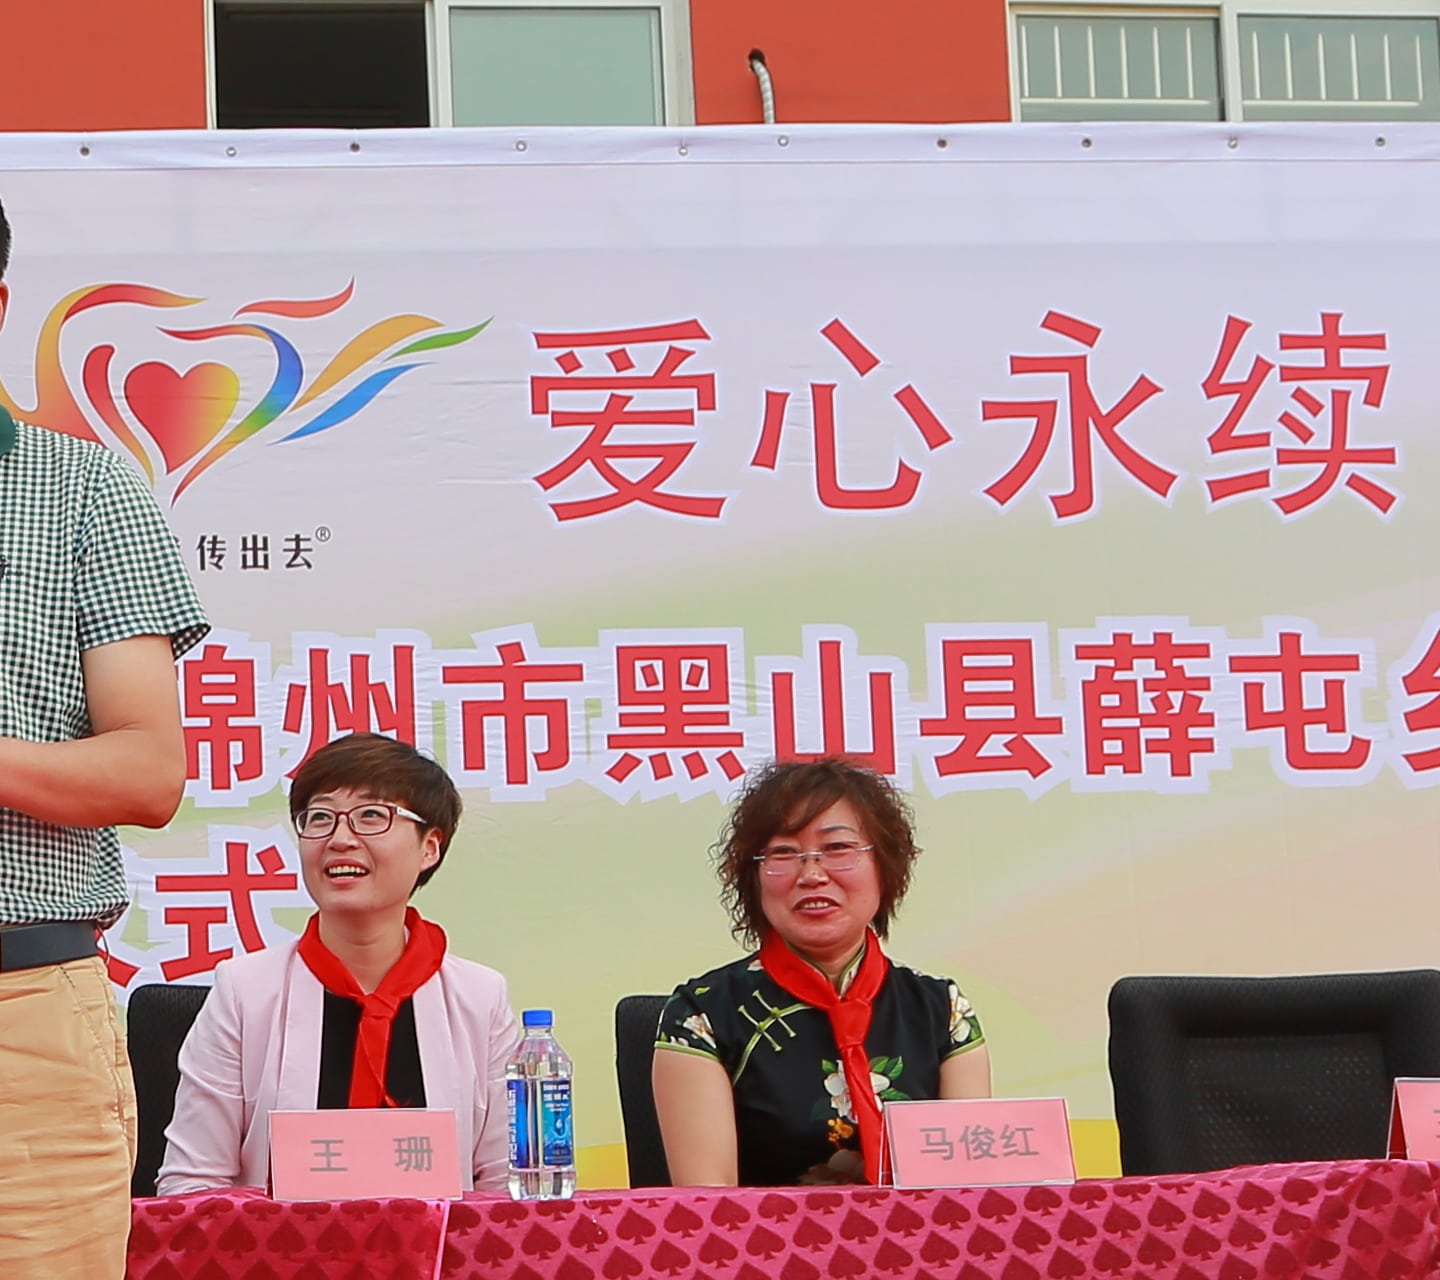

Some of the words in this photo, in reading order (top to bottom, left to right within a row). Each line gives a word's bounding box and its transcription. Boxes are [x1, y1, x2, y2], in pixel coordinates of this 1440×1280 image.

[530, 311, 1399, 522] 爱心永续
[919, 1125, 1040, 1161] 马俊红
